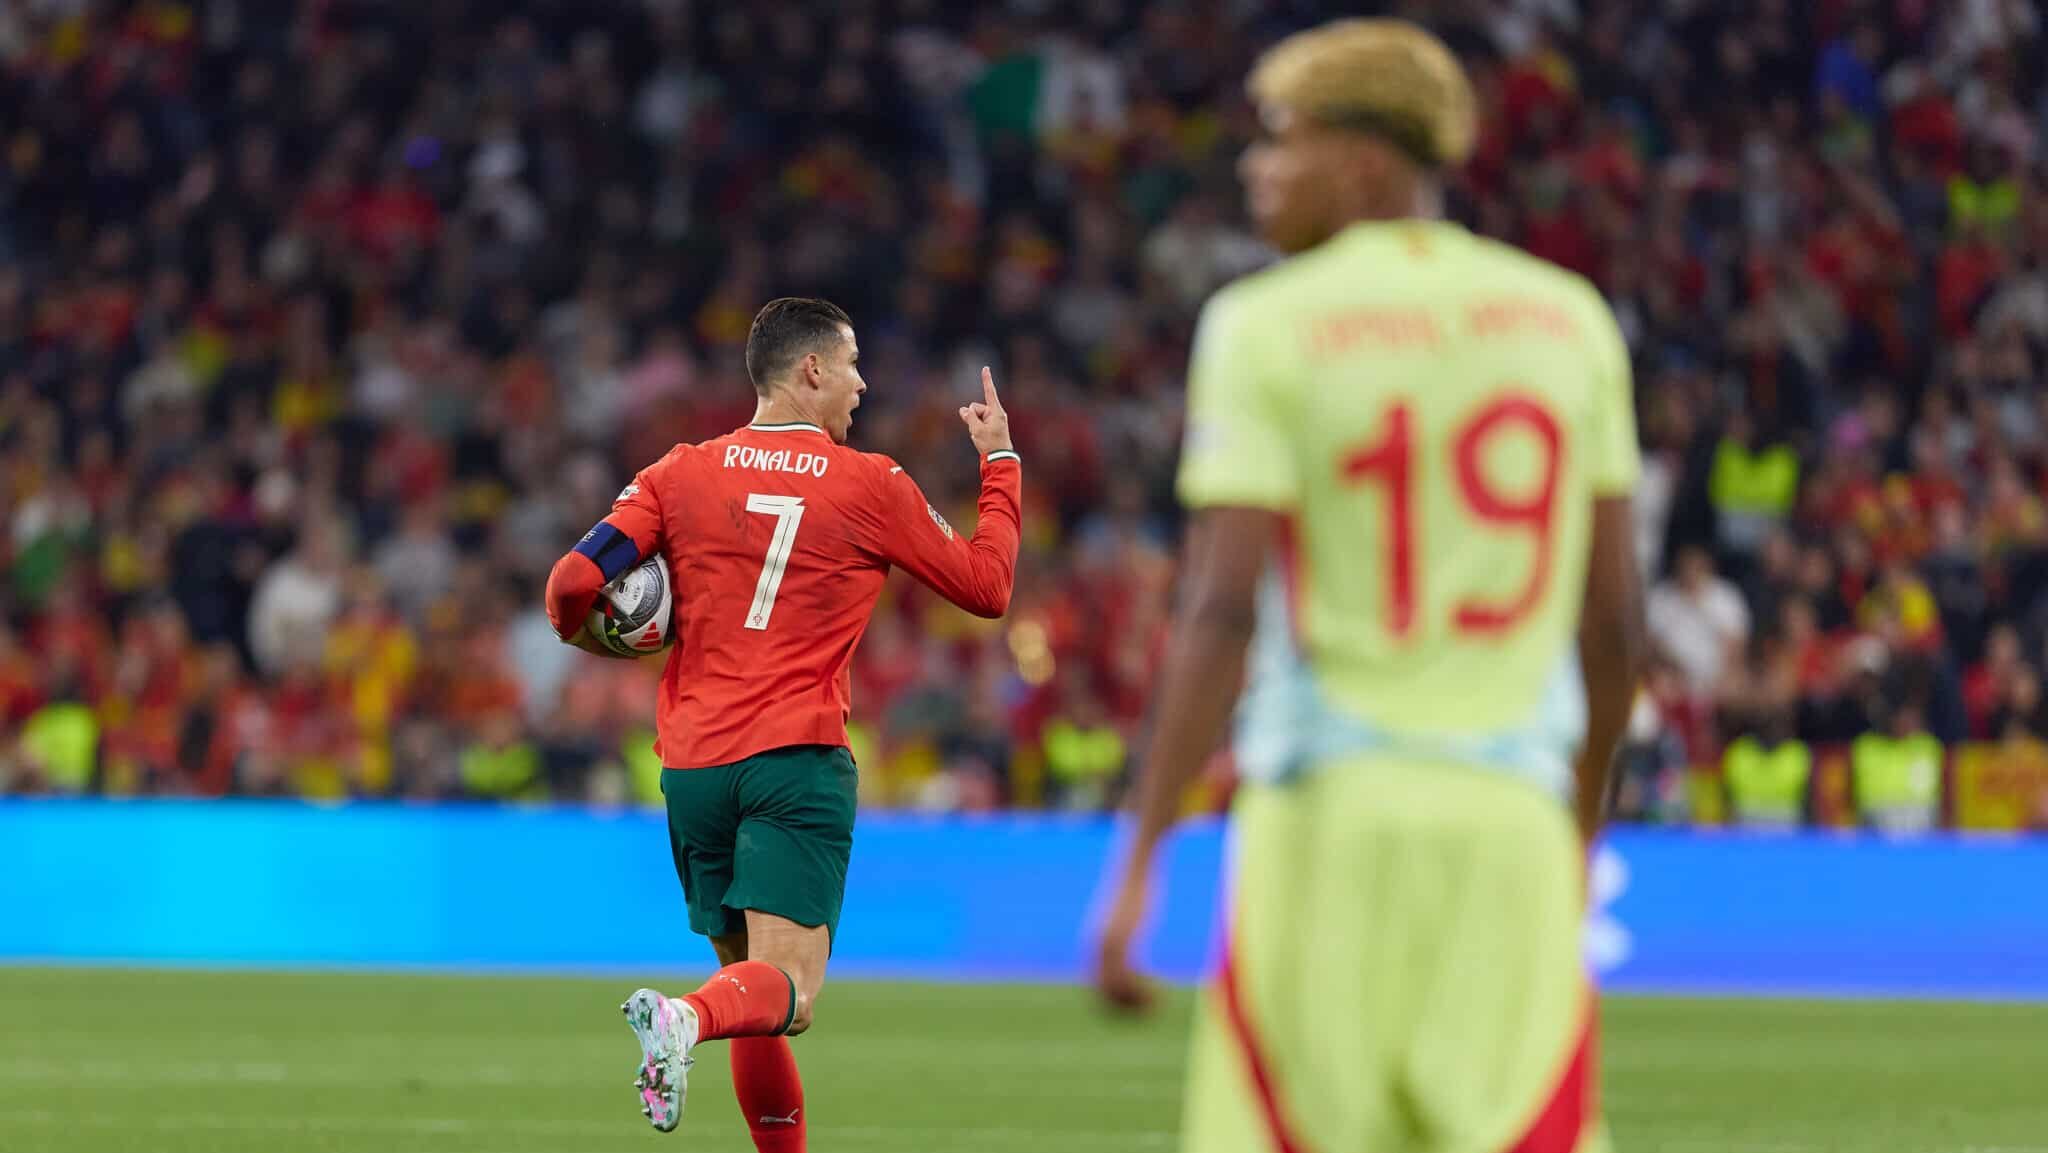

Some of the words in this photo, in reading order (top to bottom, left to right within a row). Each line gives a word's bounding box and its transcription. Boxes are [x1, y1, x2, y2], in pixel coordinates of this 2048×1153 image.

[723, 445, 828, 478] RONALDO
[1338, 391, 1566, 640] 19
[744, 493, 805, 630] 7
